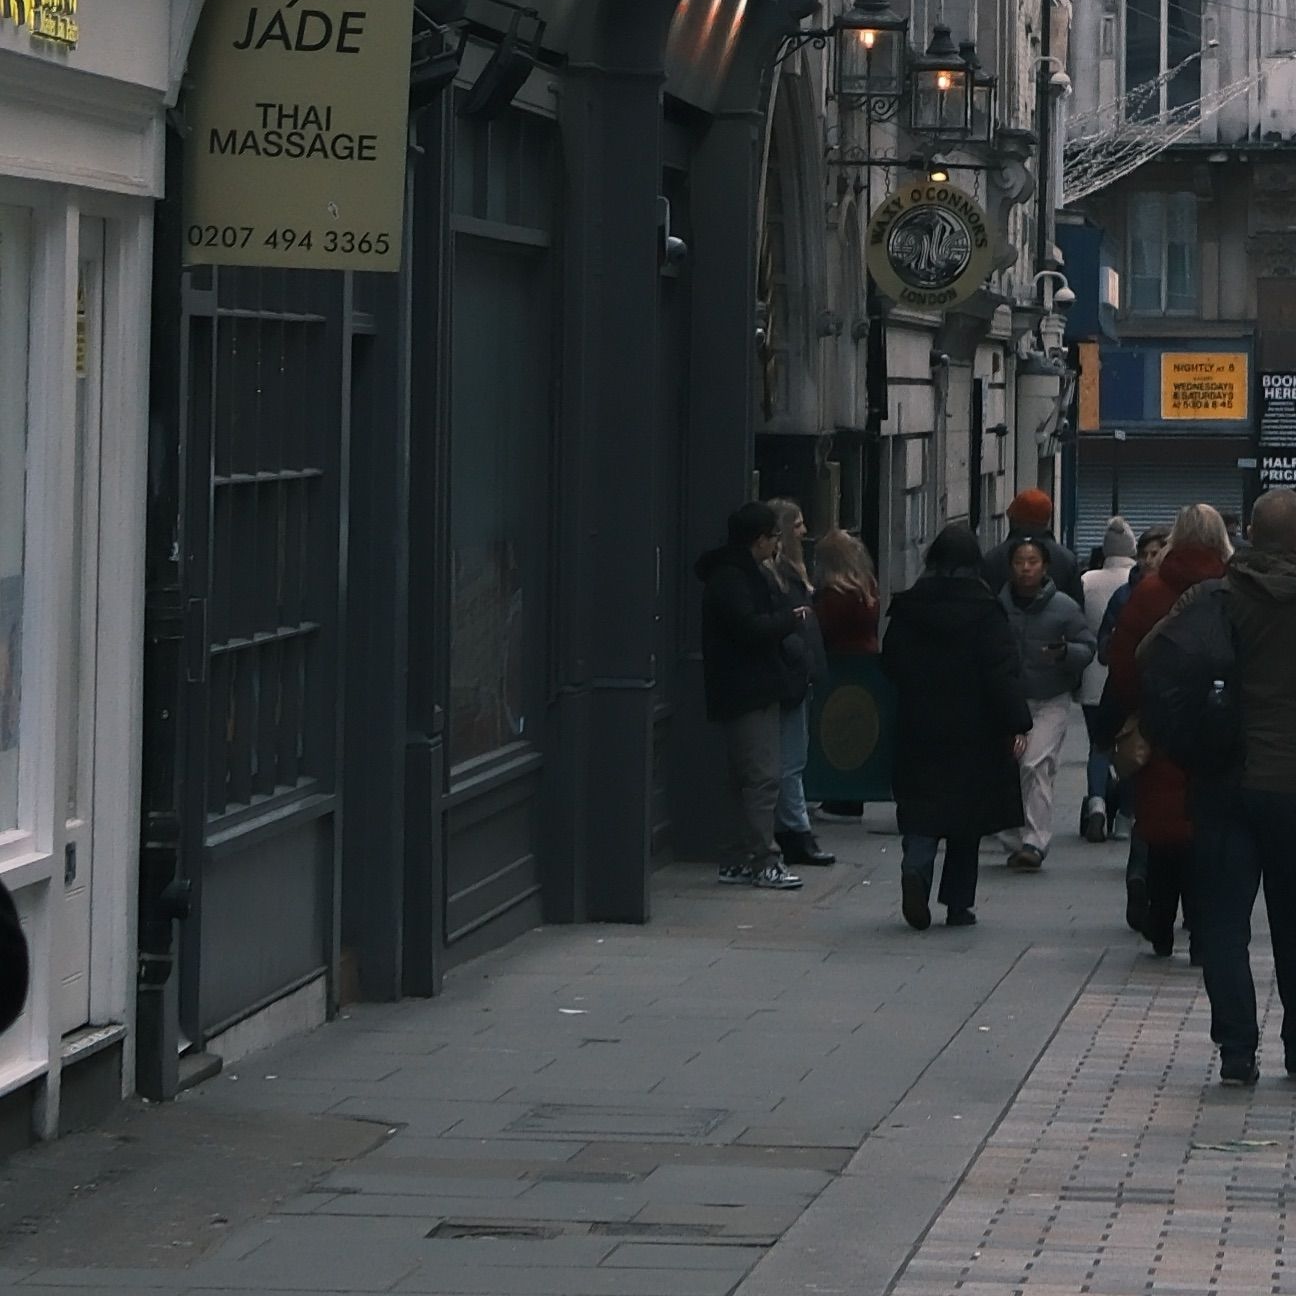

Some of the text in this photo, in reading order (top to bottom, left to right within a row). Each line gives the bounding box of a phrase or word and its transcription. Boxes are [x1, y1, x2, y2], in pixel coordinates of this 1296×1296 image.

[233, 8, 366, 53] JADE
[256, 103, 331, 132] THAI
[209, 128, 377, 161] MASSAGE
[871, 196, 906, 246] WAXY
[187, 225, 390, 255] 0207 494 3365
[899, 287, 958, 306] LONDON
[1173, 363, 1214, 372] NIGHTLY
